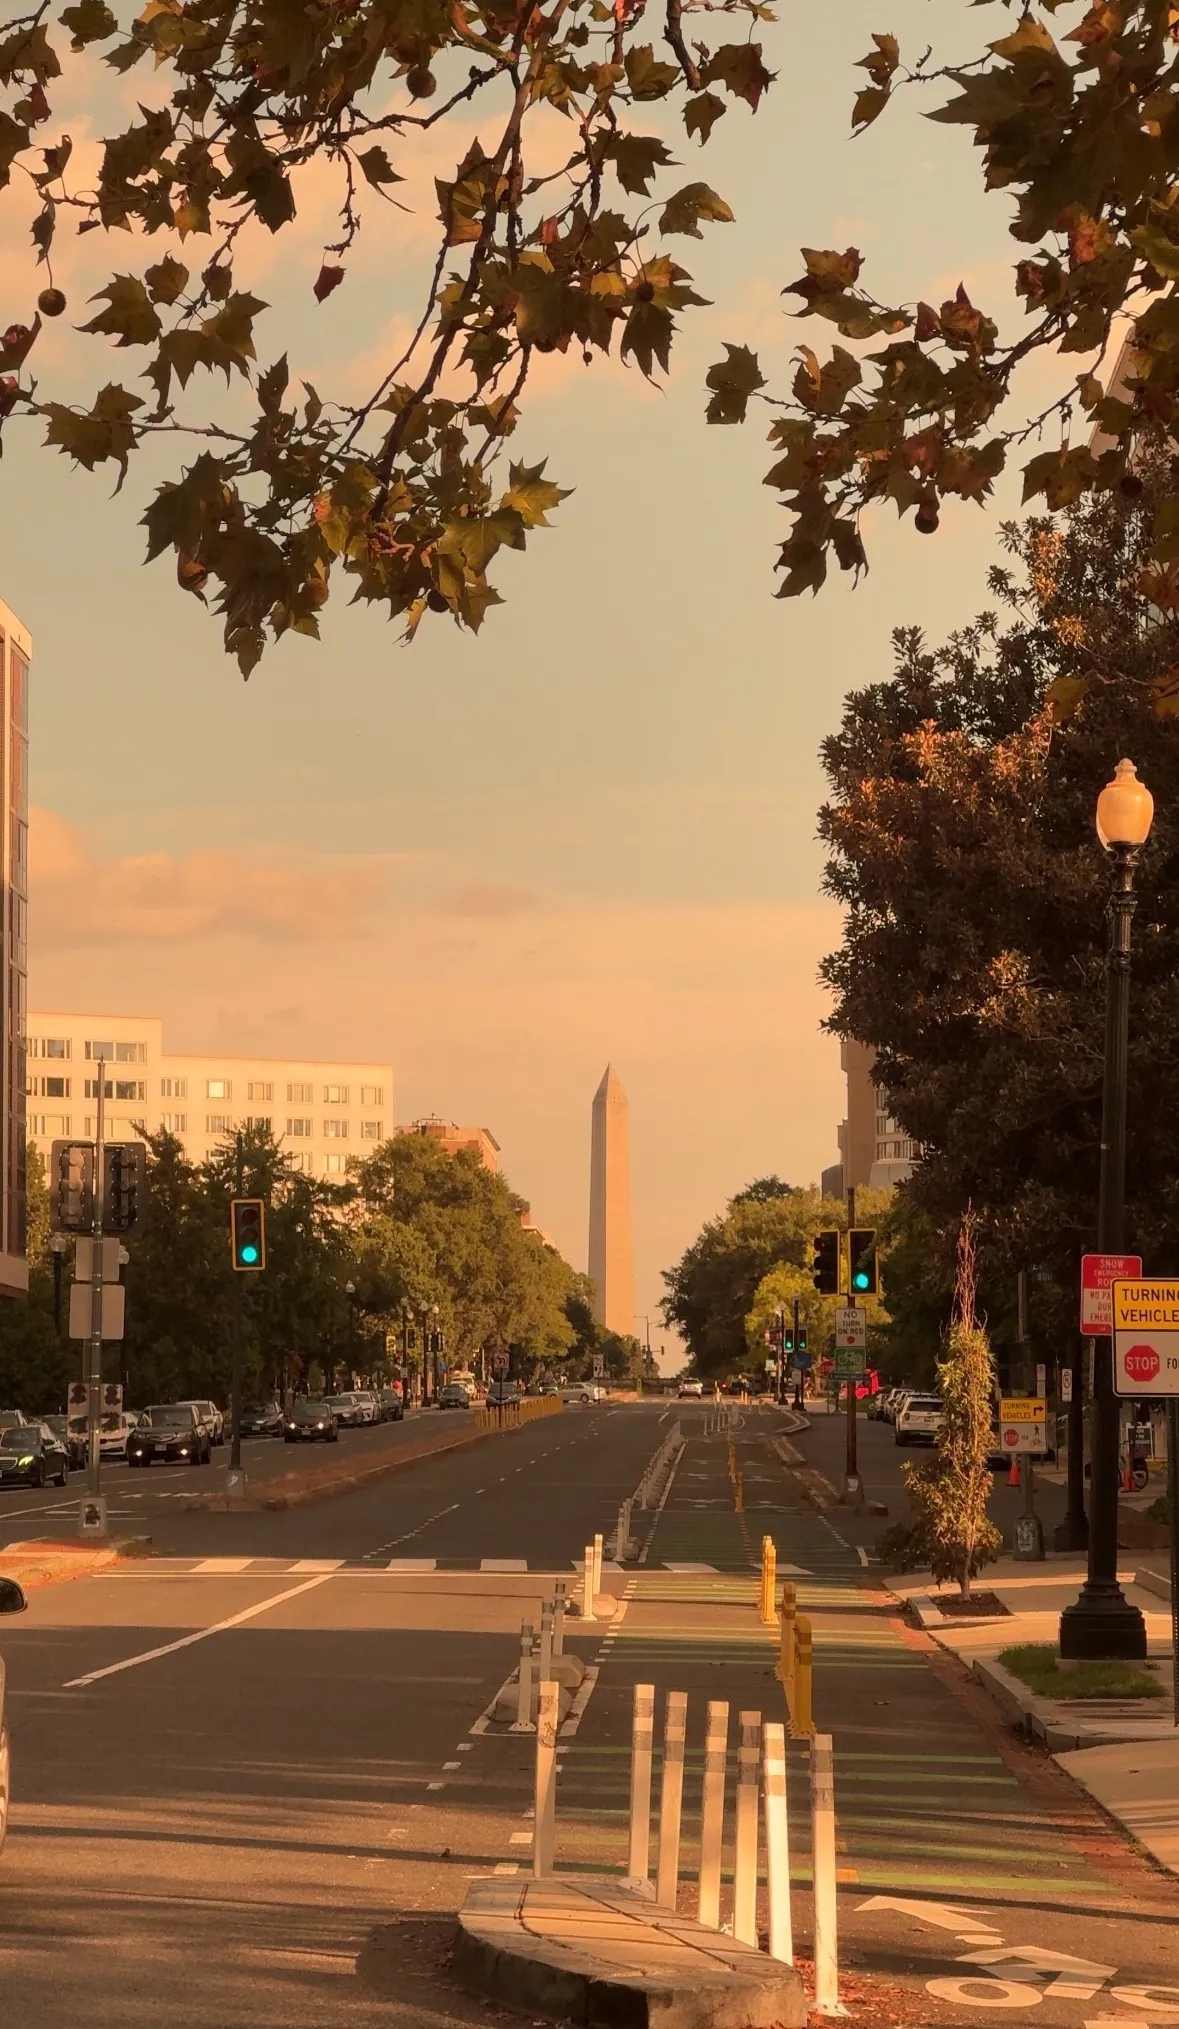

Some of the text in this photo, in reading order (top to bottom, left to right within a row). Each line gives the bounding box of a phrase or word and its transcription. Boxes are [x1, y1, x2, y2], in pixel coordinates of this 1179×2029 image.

[1099, 1258, 1125, 1268] SNOW
[1097, 1278, 1111, 1287] RO
[1090, 1291, 1100, 1299] NO
[1122, 1289, 1179, 1302] TURNIN
[843, 1311, 858, 1319] NO
[1125, 1356, 1179, 1371] STOP FO
[1004, 1402, 1031, 1410] TURNING
[1002, 1411, 1032, 1420] VEHICLES
